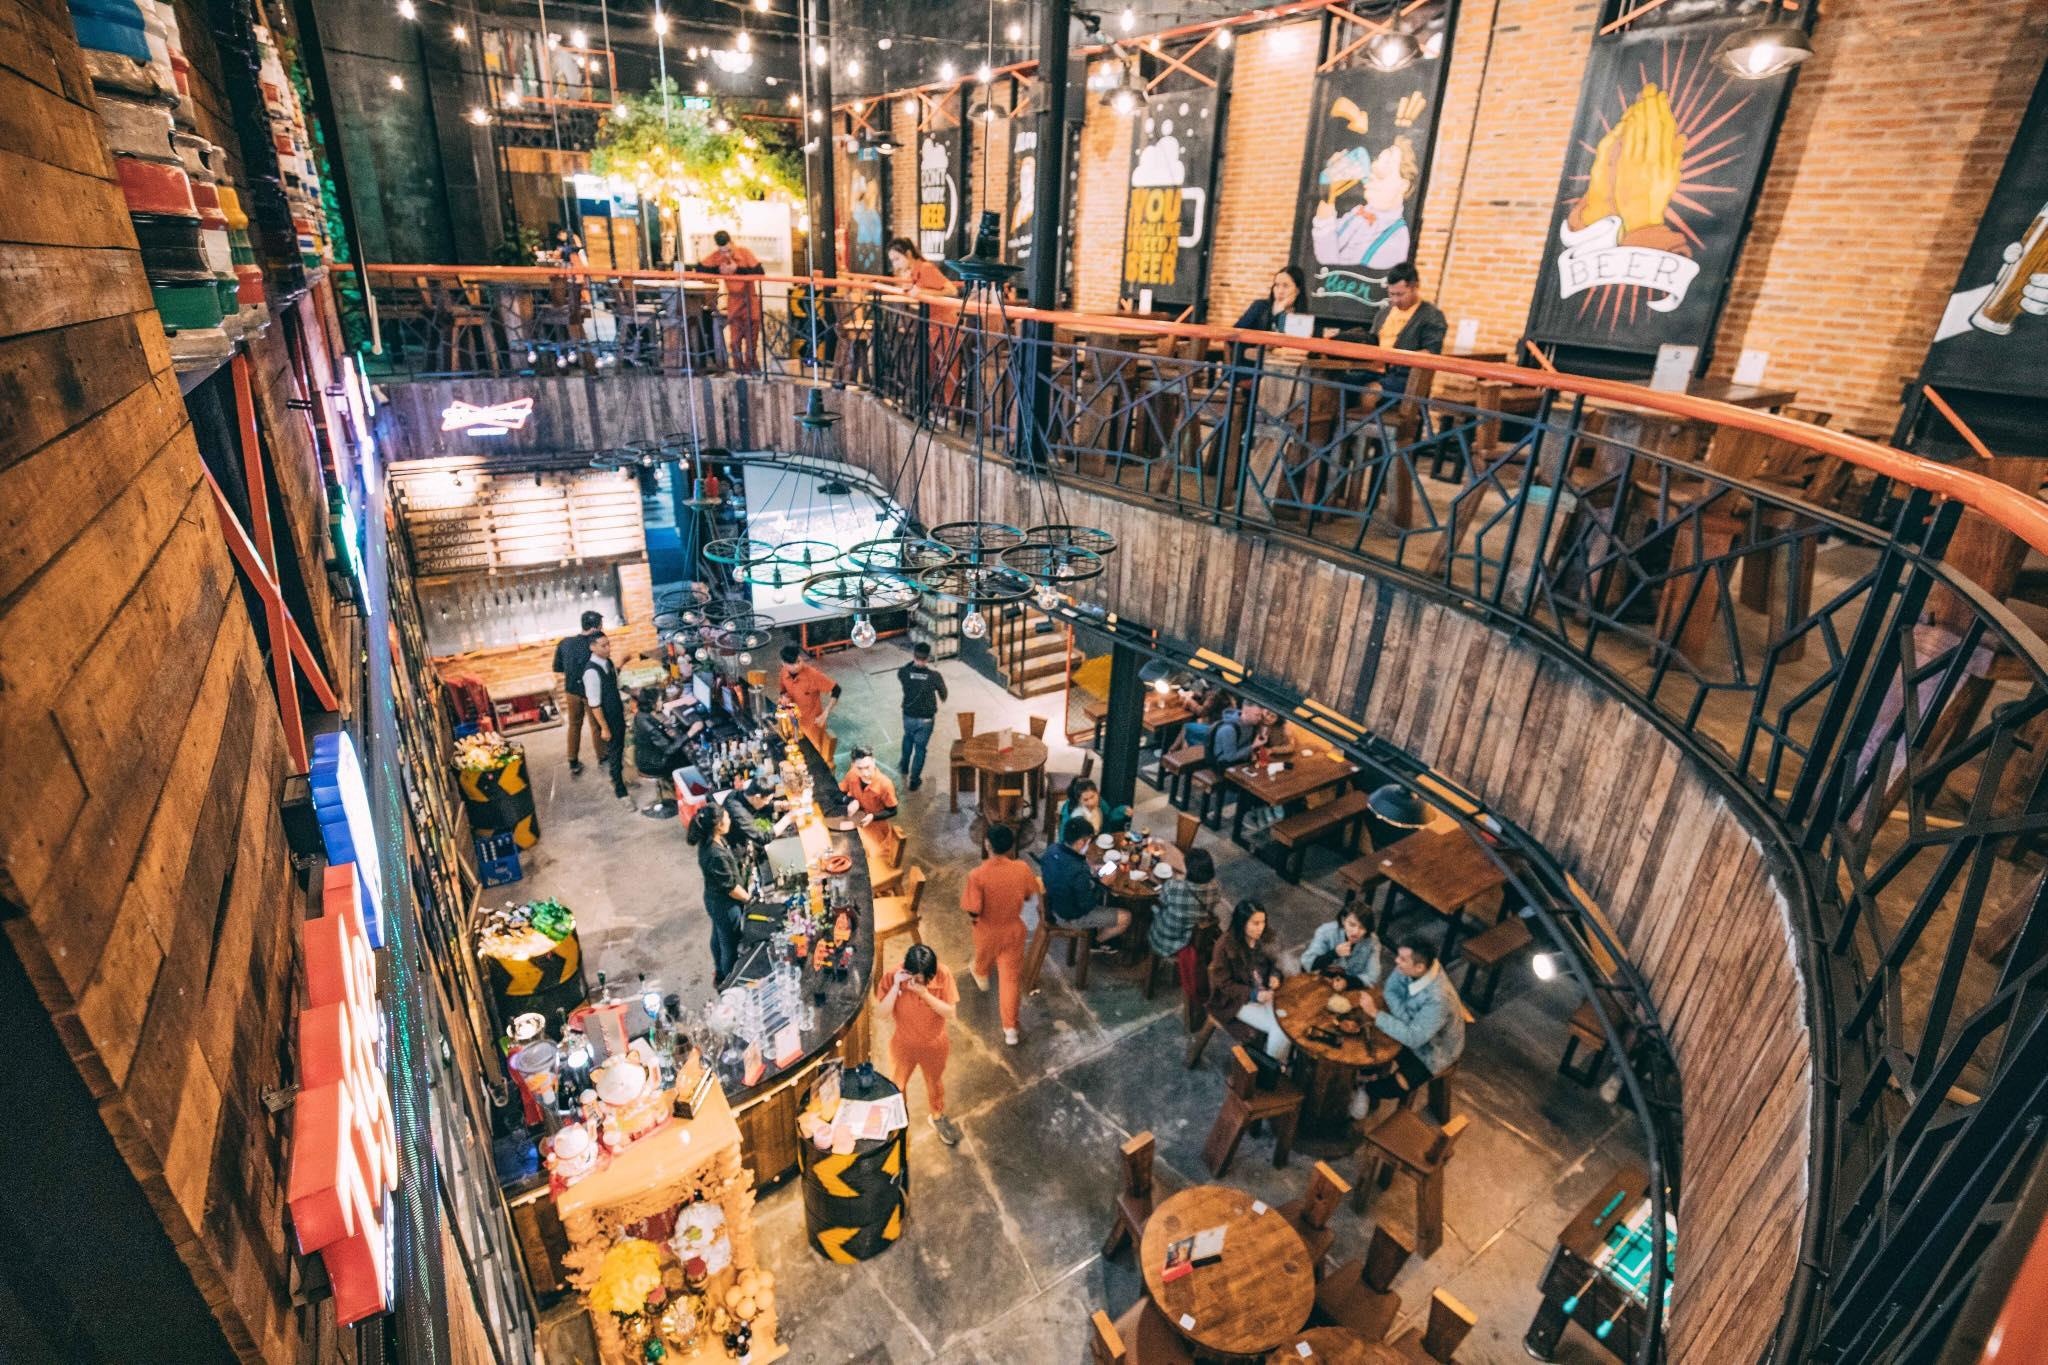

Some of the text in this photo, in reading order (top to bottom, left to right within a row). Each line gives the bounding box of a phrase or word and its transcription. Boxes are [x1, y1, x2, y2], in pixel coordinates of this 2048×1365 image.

[1130, 188, 1182, 223] YOU
[1126, 251, 1175, 285] BEER
[1569, 252, 1680, 286] BEER
[336, 863, 398, 1310] Tiger
